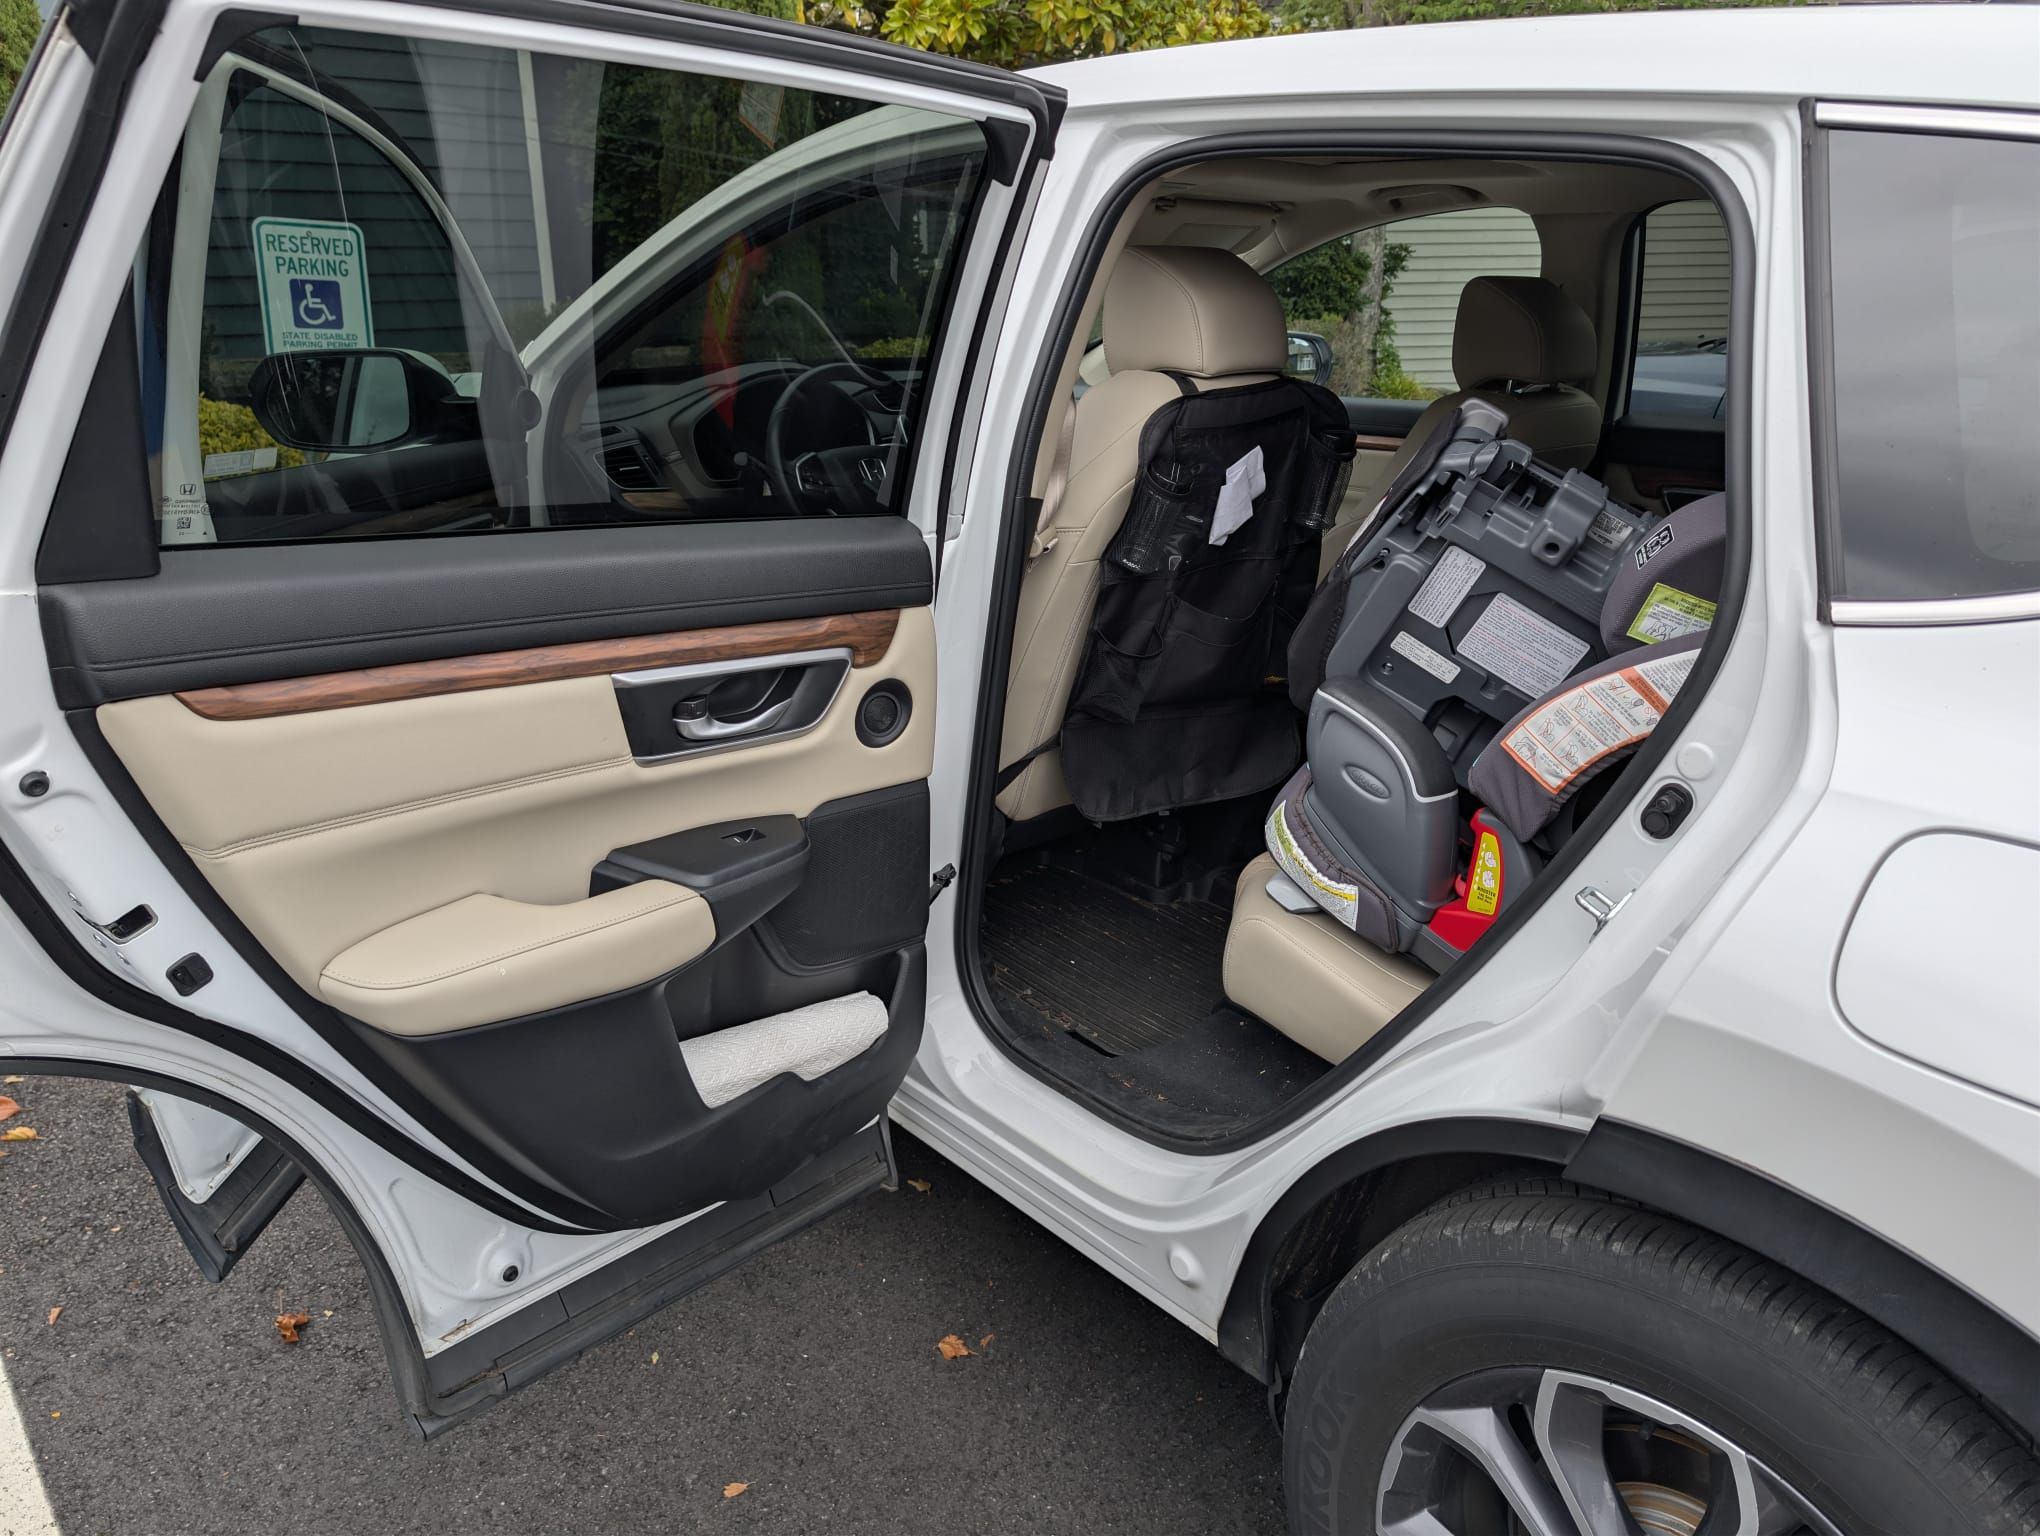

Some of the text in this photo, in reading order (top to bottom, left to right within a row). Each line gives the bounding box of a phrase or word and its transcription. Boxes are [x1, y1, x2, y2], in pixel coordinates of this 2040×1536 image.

[265, 233, 353, 256] RESERVED
[275, 256, 349, 277] PARKING
[282, 331, 358, 341] STATE DISABLED
[283, 340, 323, 348] PARKING
